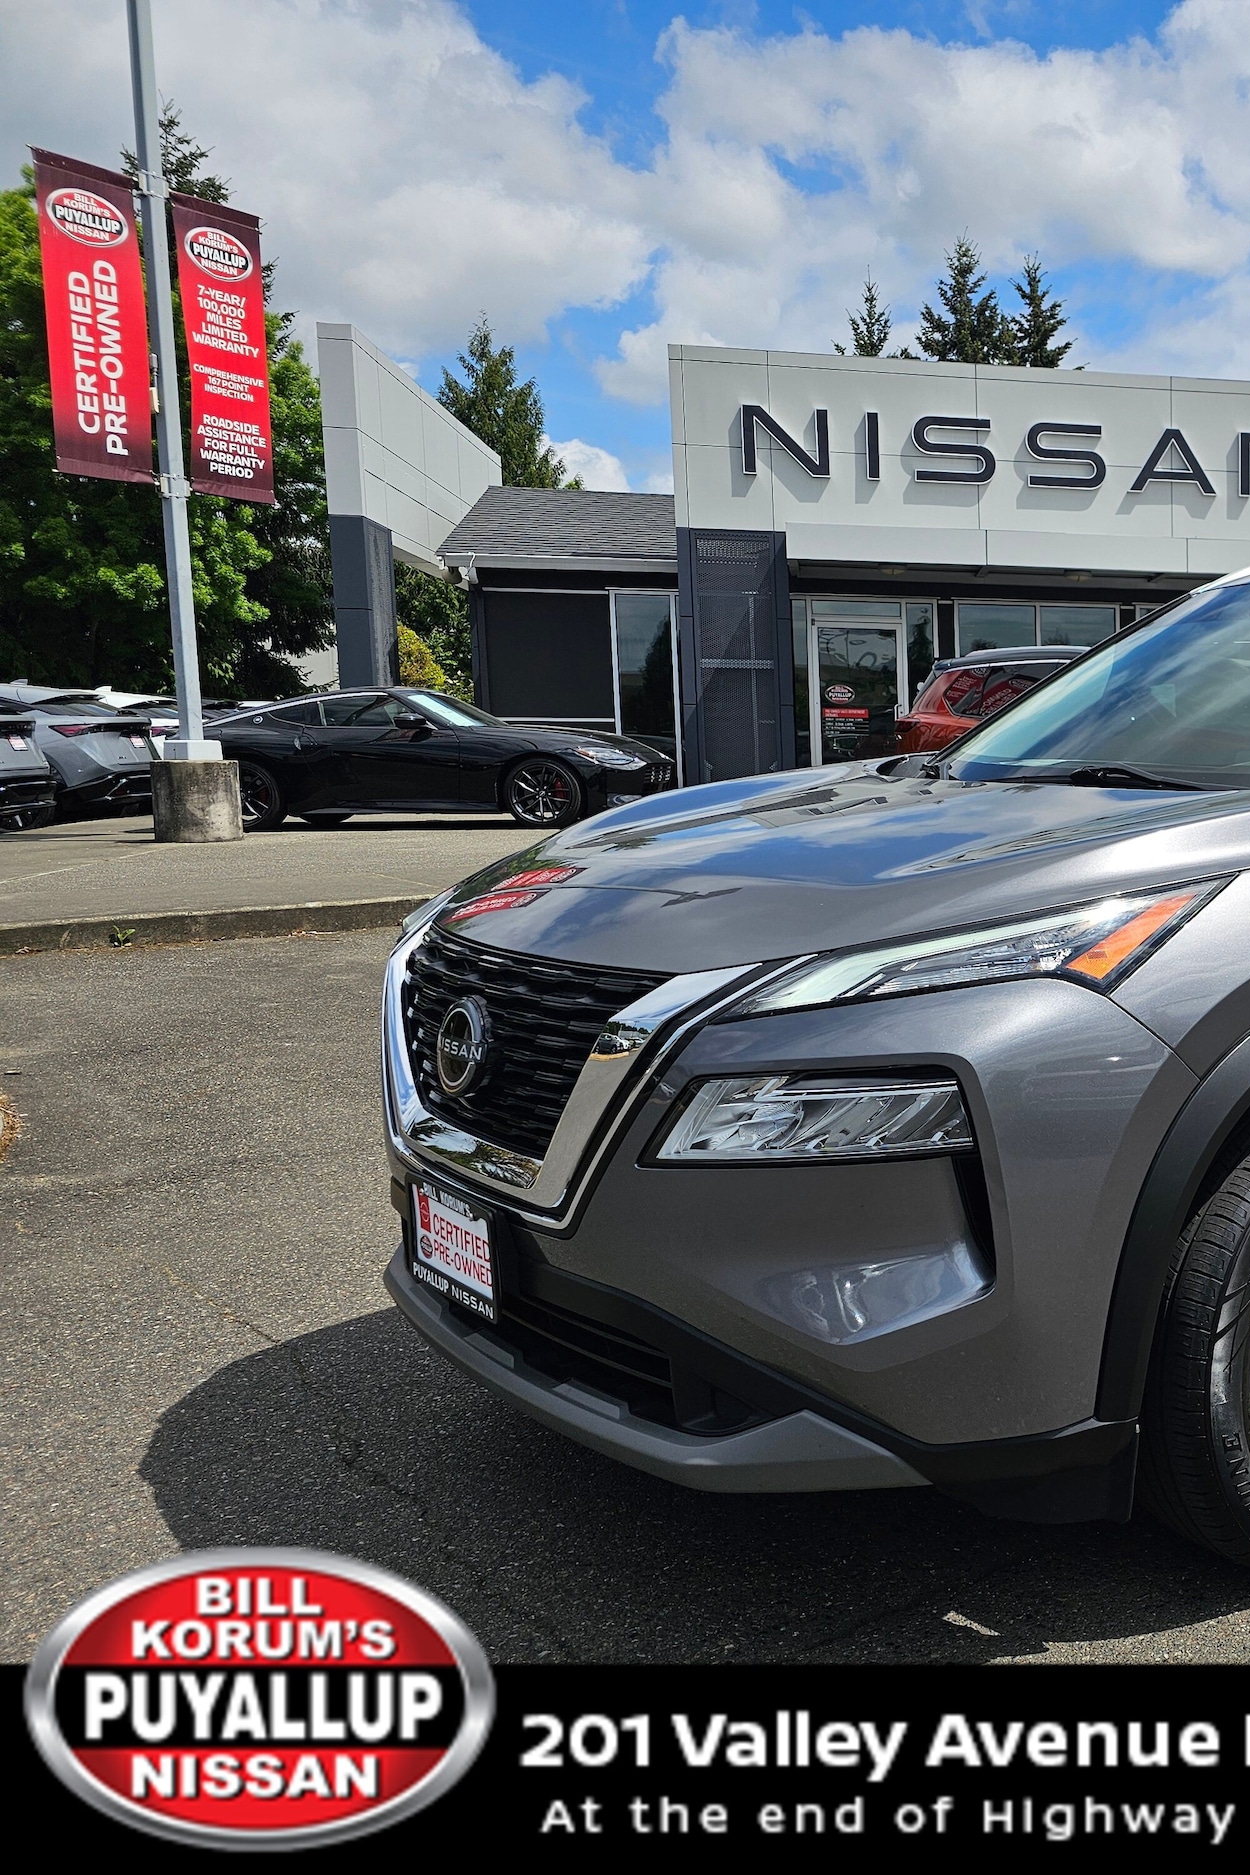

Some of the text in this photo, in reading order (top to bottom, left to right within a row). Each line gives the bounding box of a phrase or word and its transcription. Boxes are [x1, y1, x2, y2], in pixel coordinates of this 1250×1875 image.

[63, 197, 111, 217] KORUM'S
[74, 193, 98, 207] BILL
[55, 205, 120, 233] PUYALLUP
[65, 222, 110, 241] NISSAN
[207, 231, 227, 244] BILL
[193, 242, 247, 269] PUYALLUP
[198, 236, 239, 254] KORUM'S
[200, 258, 238, 276] NISSAN
[197, 284, 246, 308] 7-YEAR/
[197, 297, 246, 319] 100,000
[206, 311, 242, 330] MILES
[201, 322, 248, 343] LIMITED
[68, 271, 100, 434] CERTIFIED
[192, 331, 259, 358] WARRANTY
[93, 260, 128, 456] PRE-OWNED
[193, 363, 265, 388] COMPREHENSIVE
[207, 376, 249, 392] 167 POINT
[204, 383, 254, 402] INSPECTION
[203, 413, 260, 435] ROADSIDE
[197, 424, 267, 448] ASSISTANCE
[204, 437, 258, 457] FOR FULL
[199, 447, 265, 469] WARRANTY
[209, 461, 254, 478] PERIOD
[440, 1037, 483, 1061] ISSAN
[423, 1182, 439, 1201] BILL
[432, 1213, 492, 1263] CERTIFIED
[433, 1238, 494, 1287] PRE-OWNED
[413, 1262, 494, 1320] PUYALLUP NISSAN
